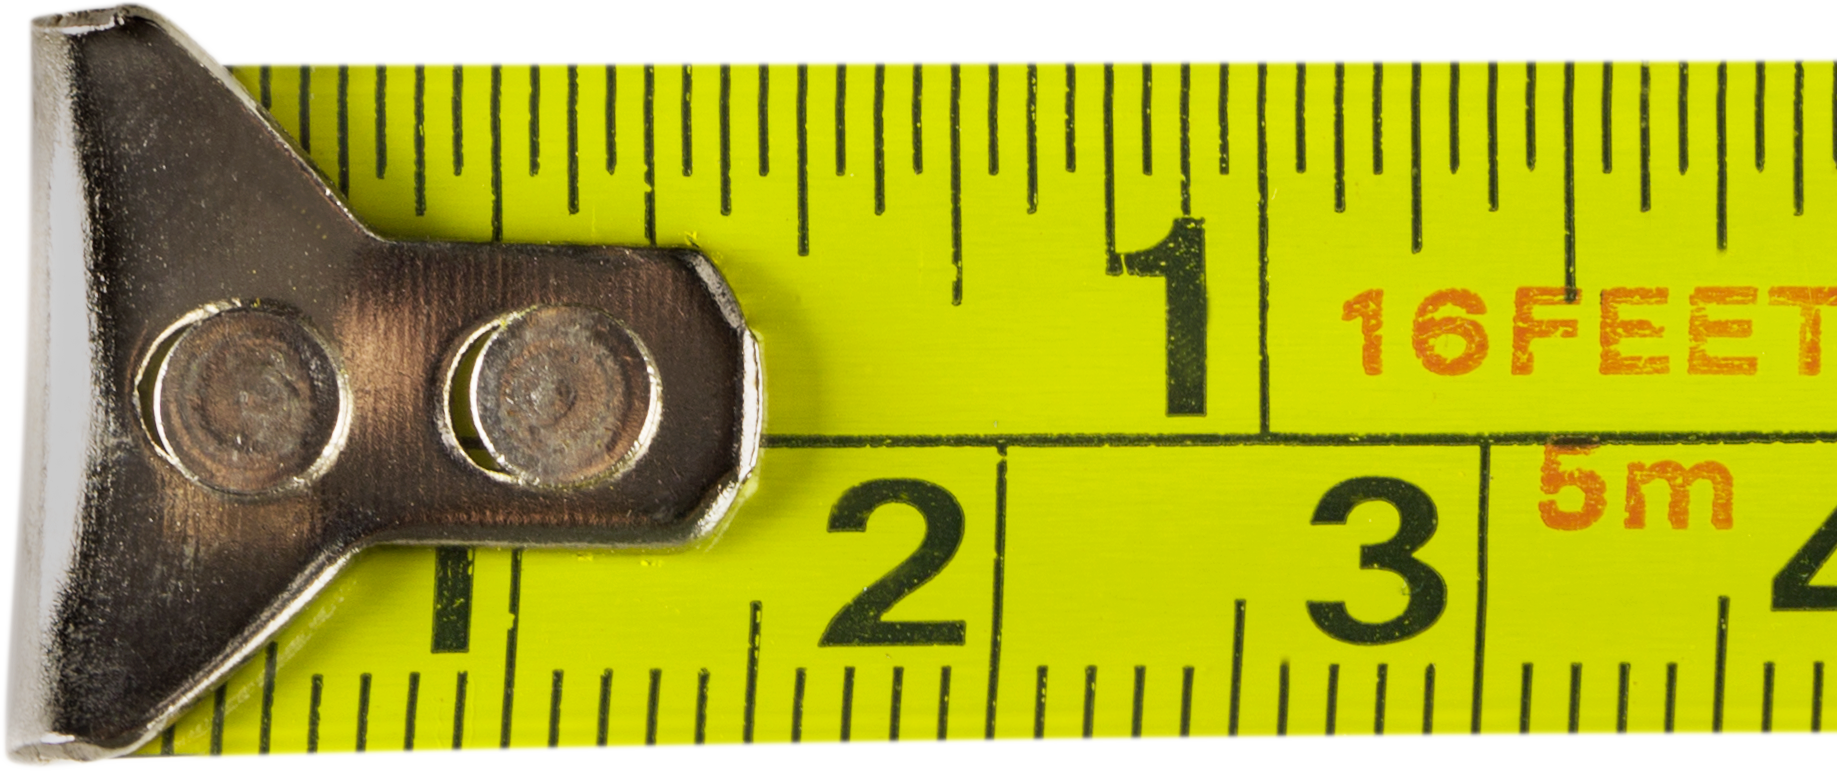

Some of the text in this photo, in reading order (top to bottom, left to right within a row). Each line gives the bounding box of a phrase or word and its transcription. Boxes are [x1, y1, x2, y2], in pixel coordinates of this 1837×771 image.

[1105, 217, 1208, 416] 1
[818, 477, 967, 647] 2
[1306, 476, 1448, 645] 3
[1538, 437, 1735, 532] 5m
